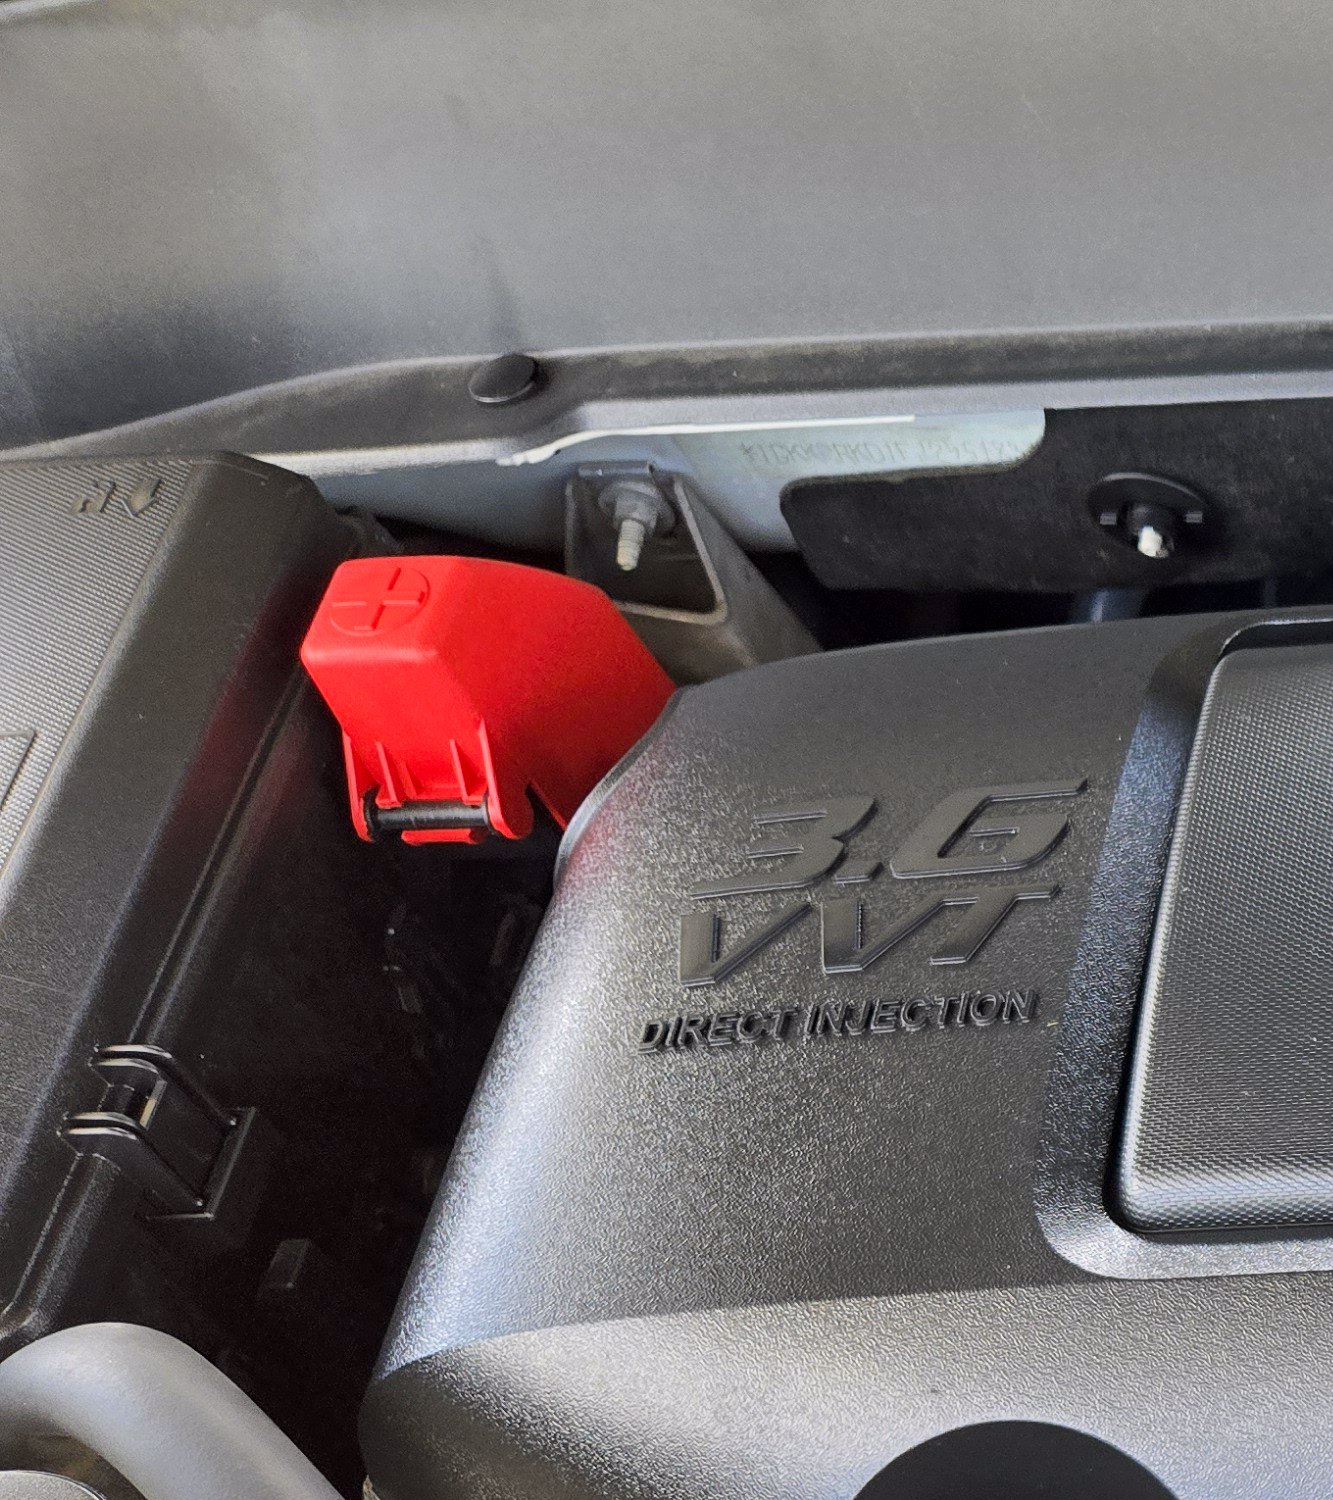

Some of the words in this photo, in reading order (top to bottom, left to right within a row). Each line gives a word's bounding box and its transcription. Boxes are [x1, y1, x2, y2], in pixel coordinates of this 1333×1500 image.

[690, 779, 1088, 900] 3.6
[679, 884, 1060, 988] VVT
[637, 1003, 800, 1054] DIRECT
[804, 988, 1040, 1038] INJECTION
